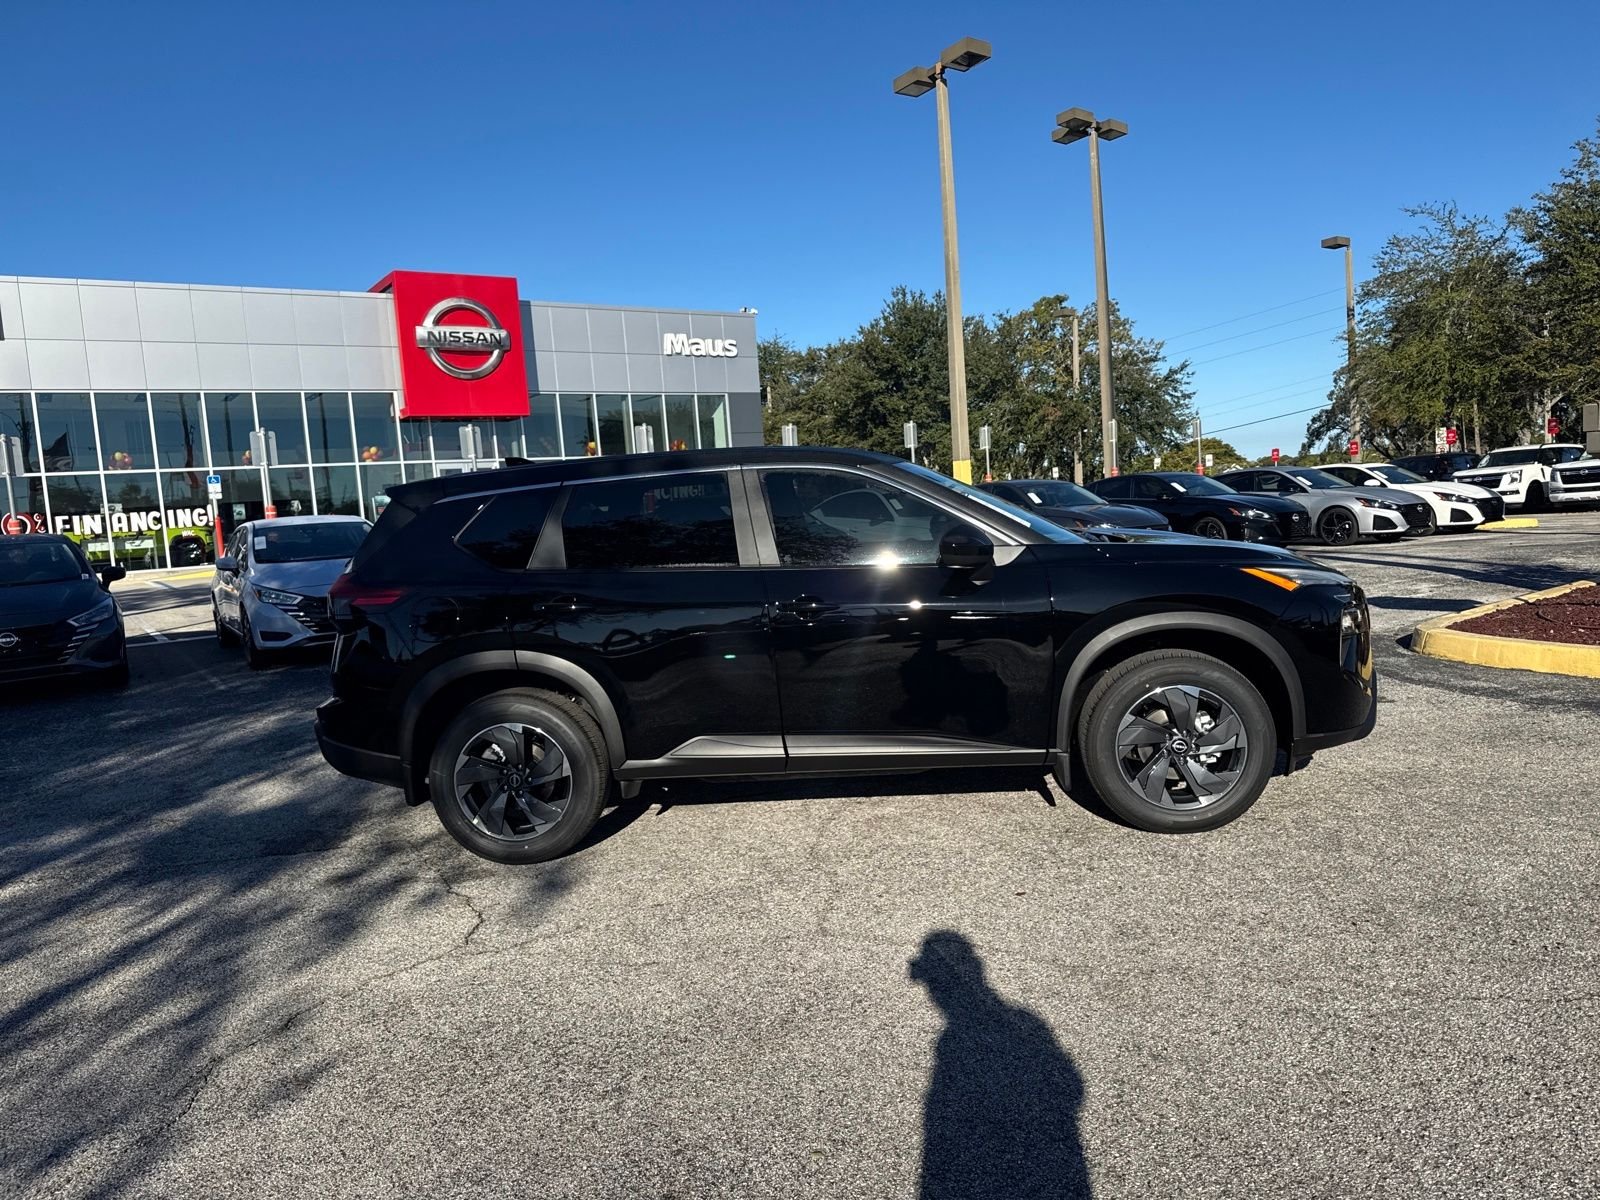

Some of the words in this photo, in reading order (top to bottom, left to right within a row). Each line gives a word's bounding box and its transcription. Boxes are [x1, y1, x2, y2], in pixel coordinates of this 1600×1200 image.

[427, 330, 502, 345] NISSAN
[663, 332, 738, 358] Maus
[54, 503, 214, 537] FINANCING!
